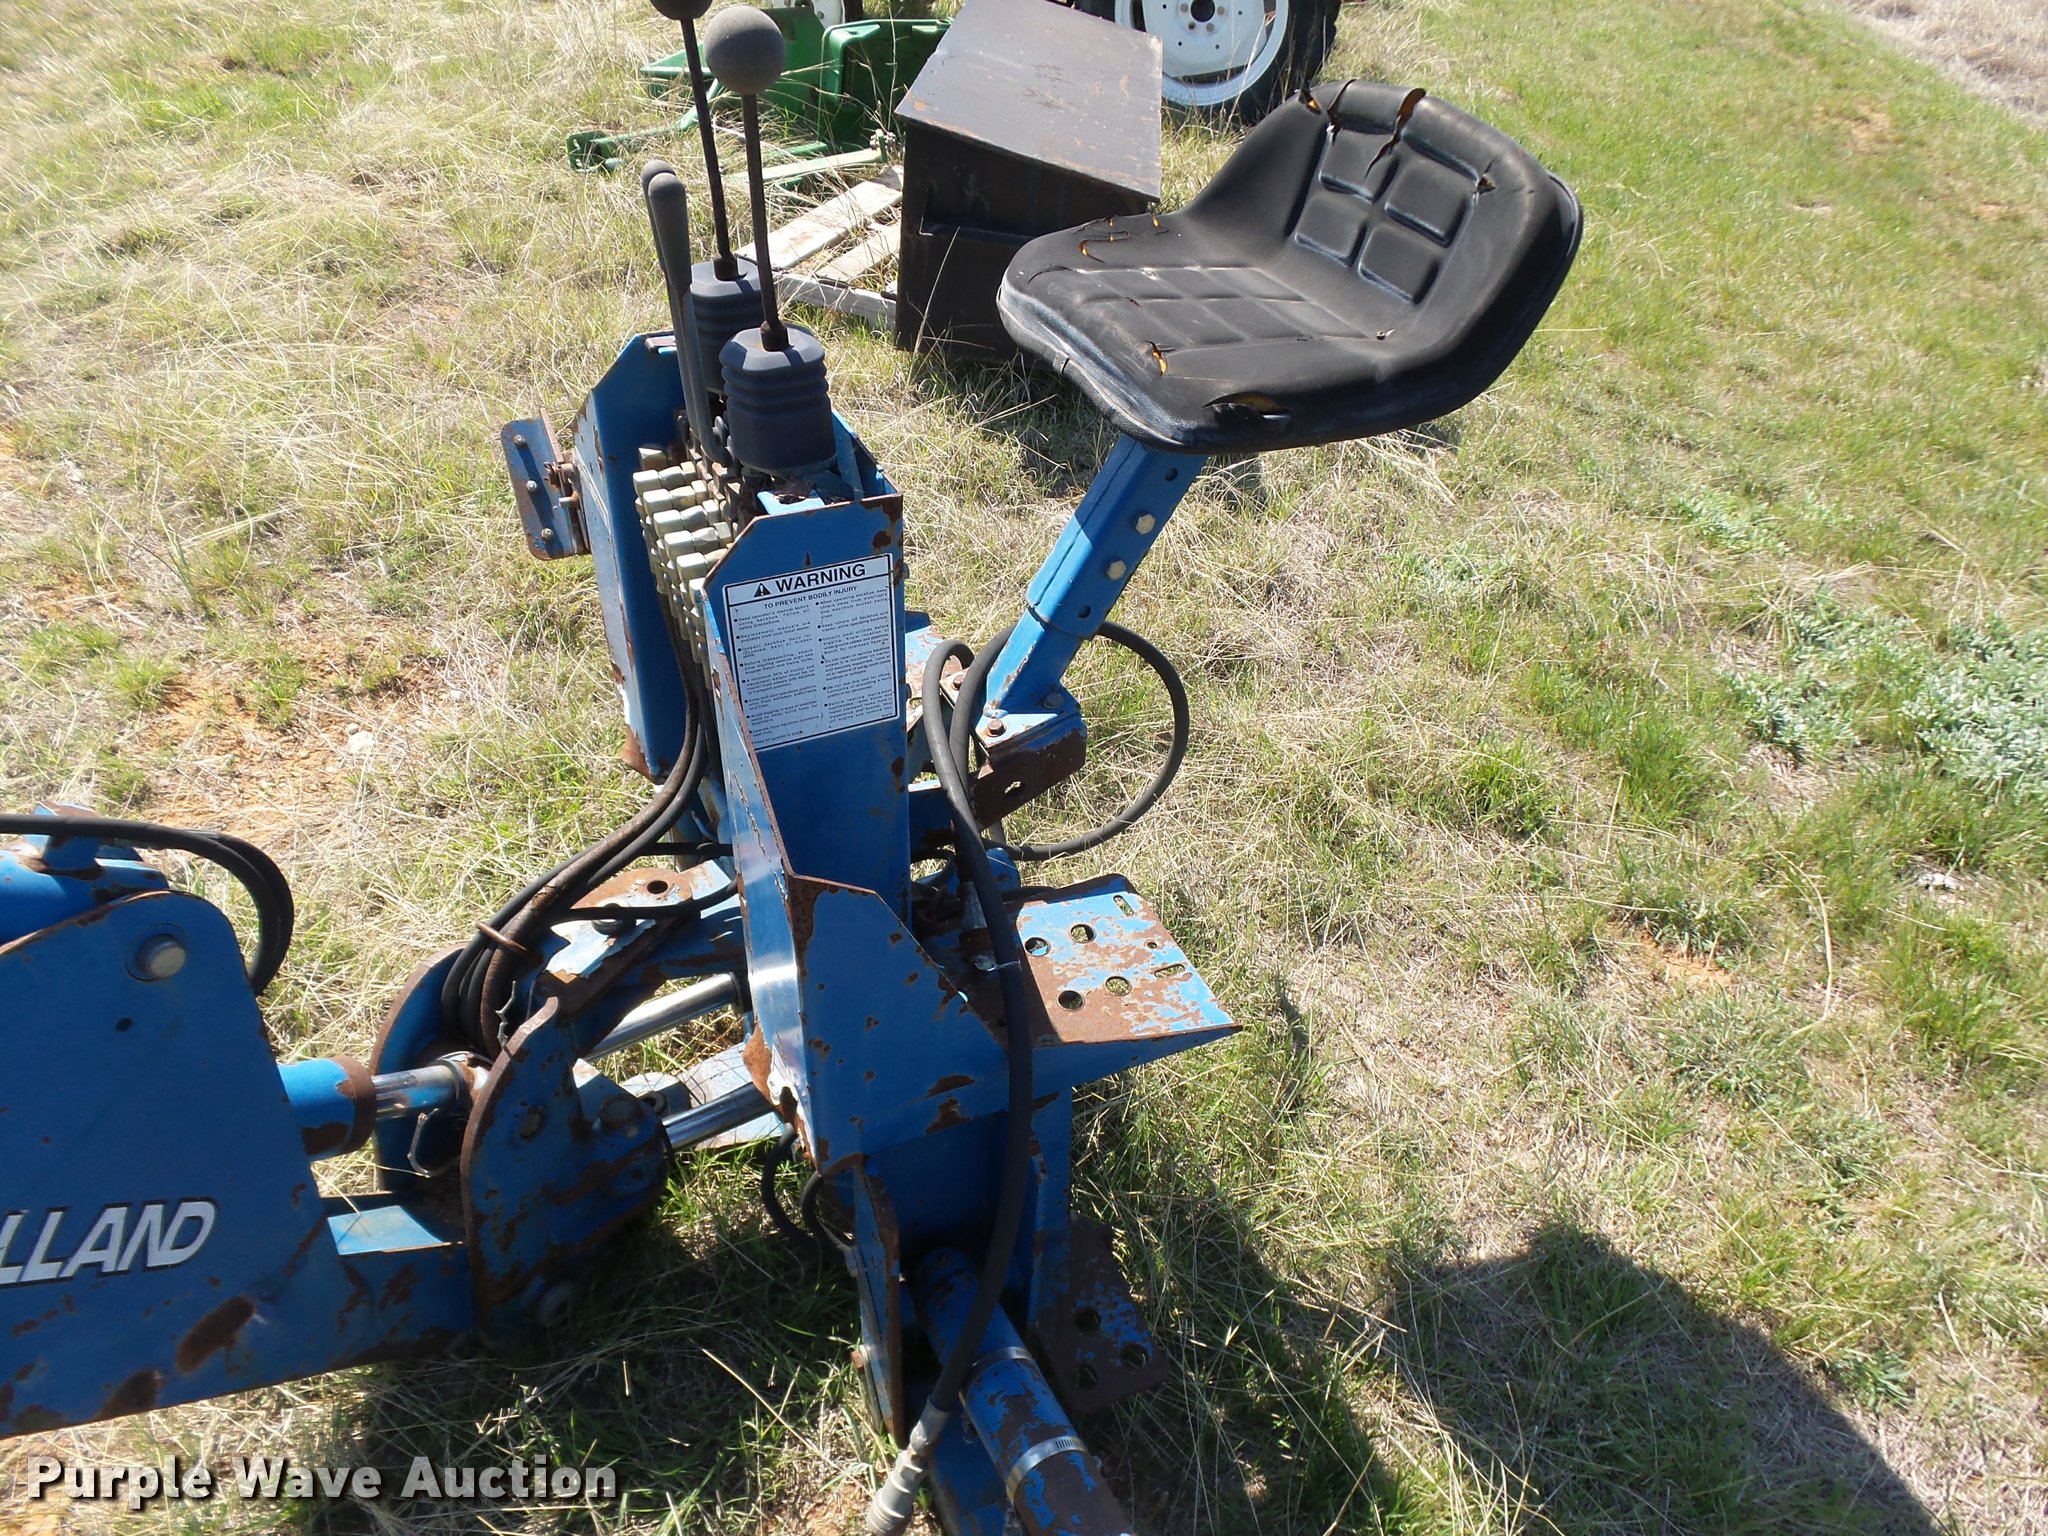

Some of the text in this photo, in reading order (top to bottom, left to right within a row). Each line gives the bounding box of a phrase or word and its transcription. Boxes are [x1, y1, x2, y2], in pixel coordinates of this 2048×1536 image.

[775, 563, 866, 593] WARNING
[774, 596, 806, 606] PREVENT
[808, 590, 831, 600] BODILY
[833, 585, 857, 594] INJURY
